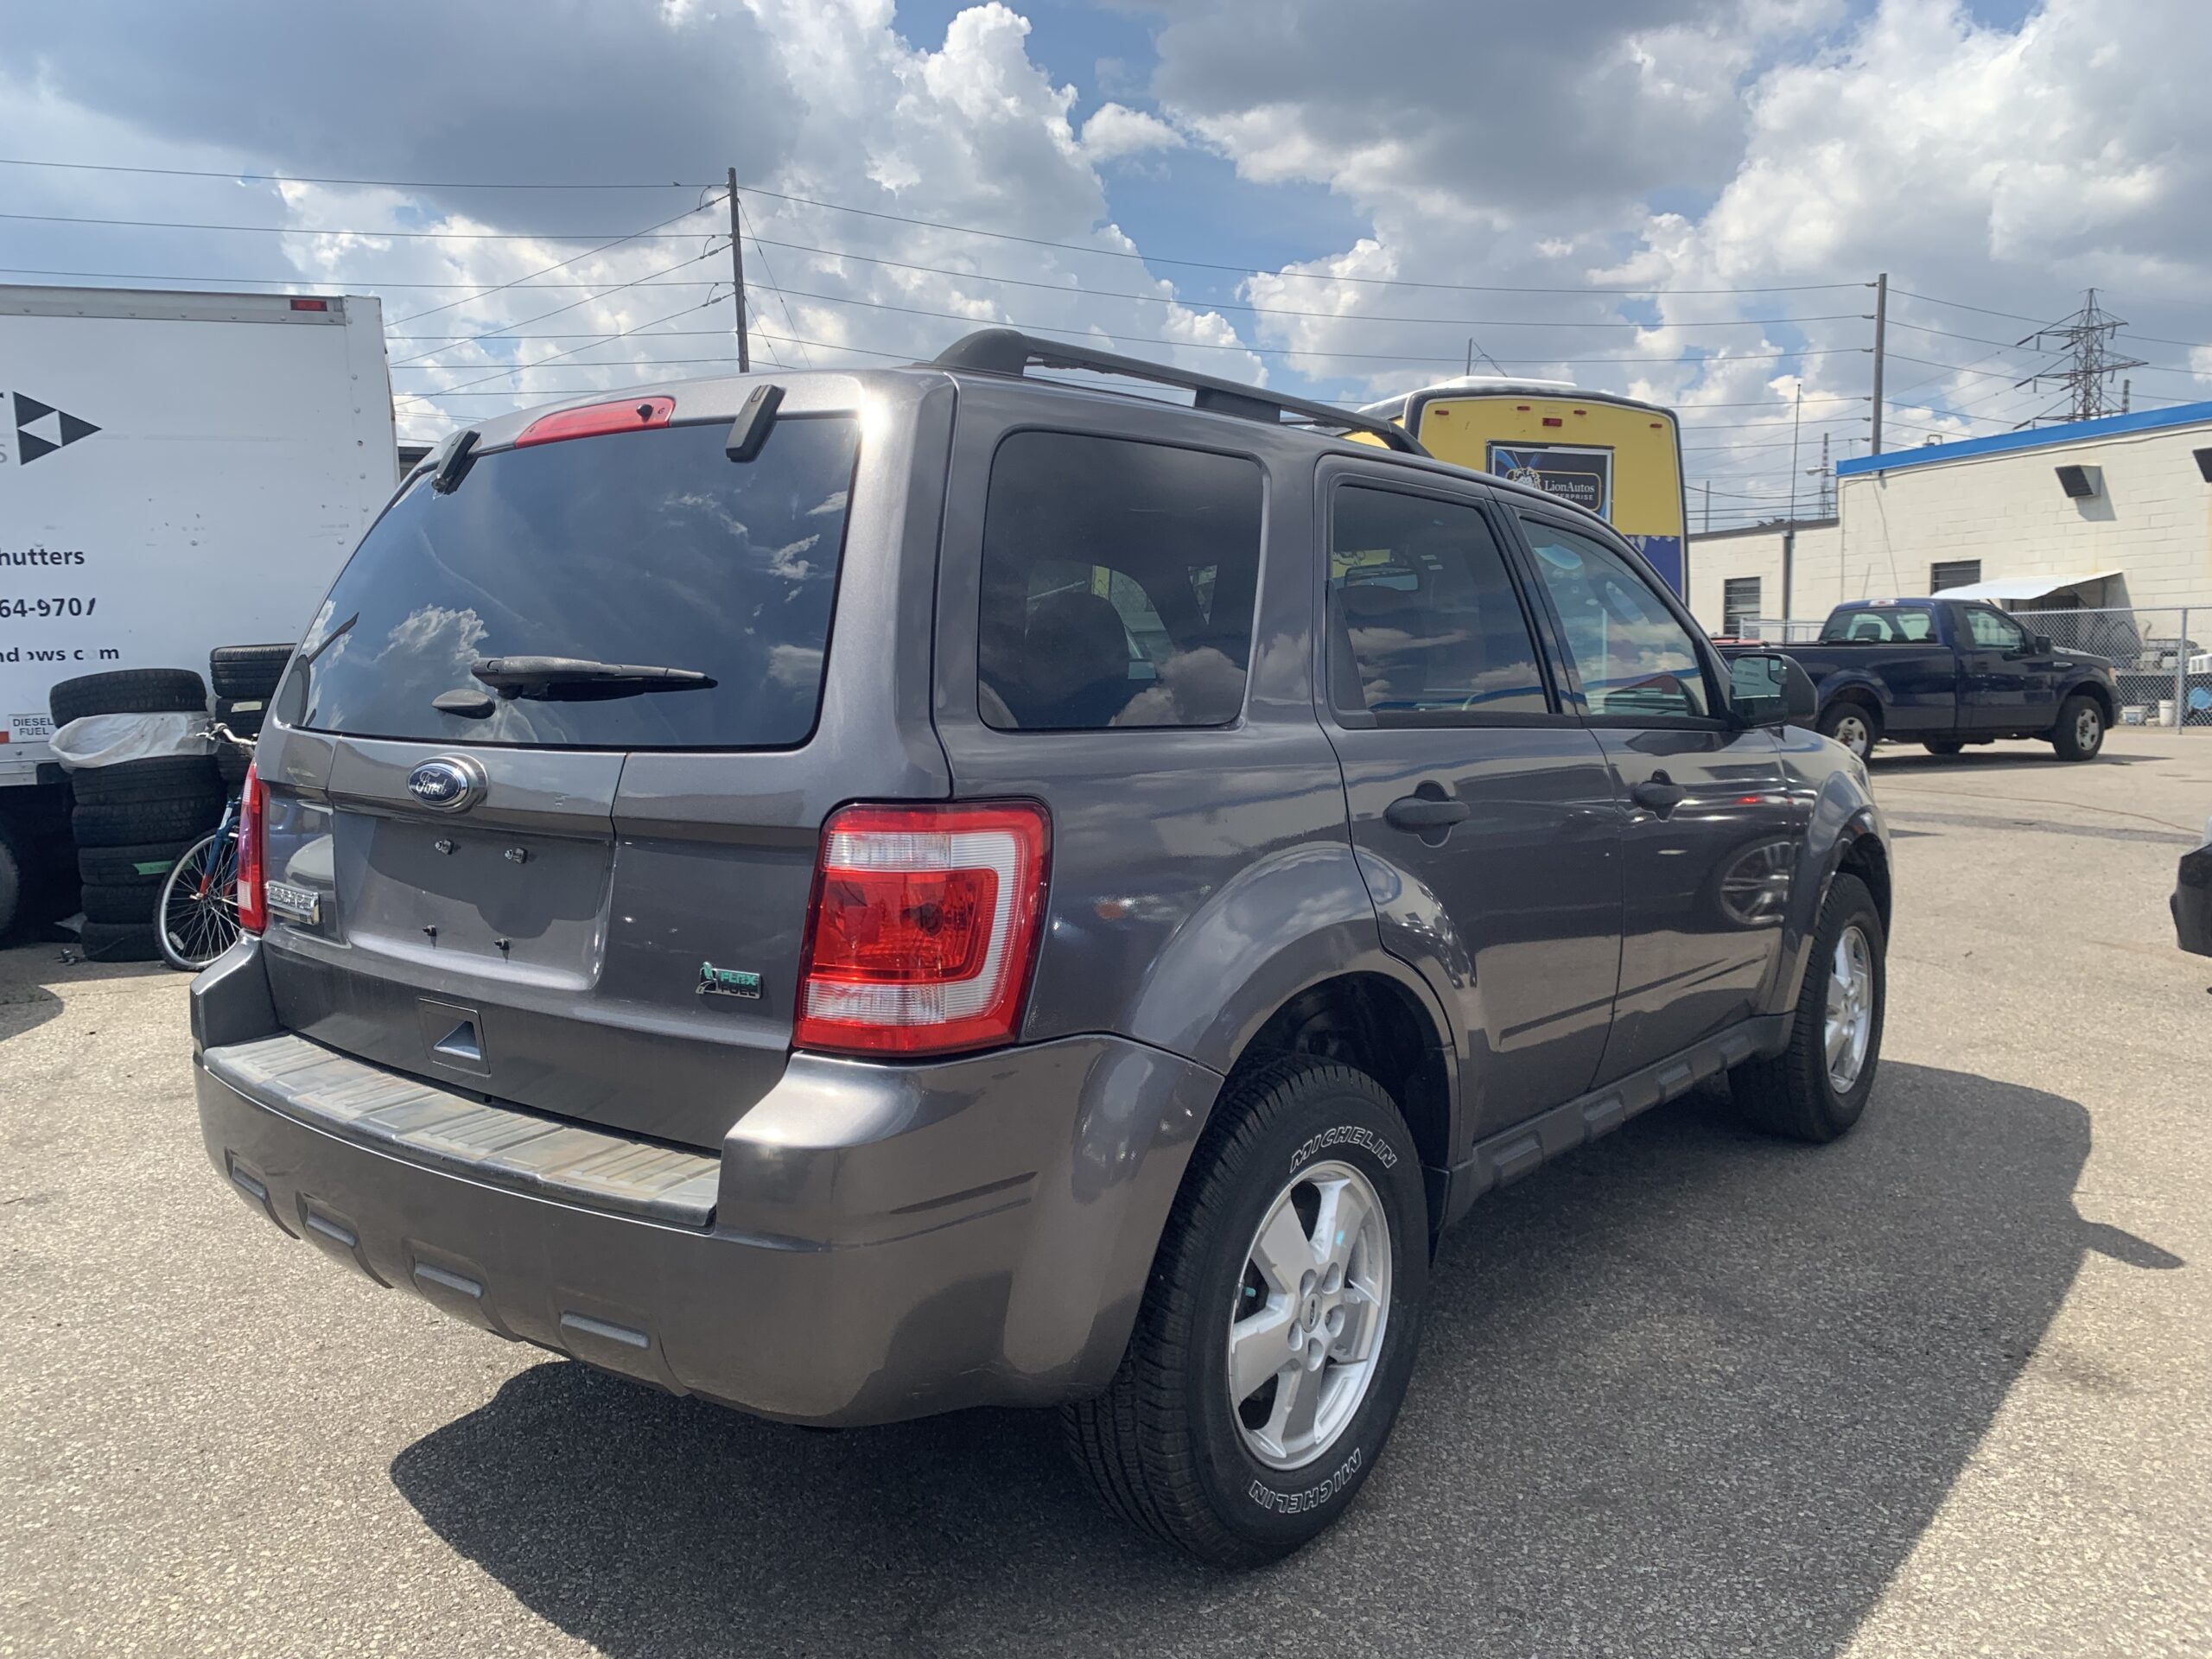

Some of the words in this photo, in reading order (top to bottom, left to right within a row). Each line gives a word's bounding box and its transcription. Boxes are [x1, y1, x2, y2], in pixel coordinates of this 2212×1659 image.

[1544, 480, 1595, 493] LionAutos
[13, 718, 54, 727] DIESEL
[416, 771, 448, 795] Ford
[1289, 1126, 1397, 1173] MICHELIN
[1249, 1447, 1362, 1514] MICHELIN
